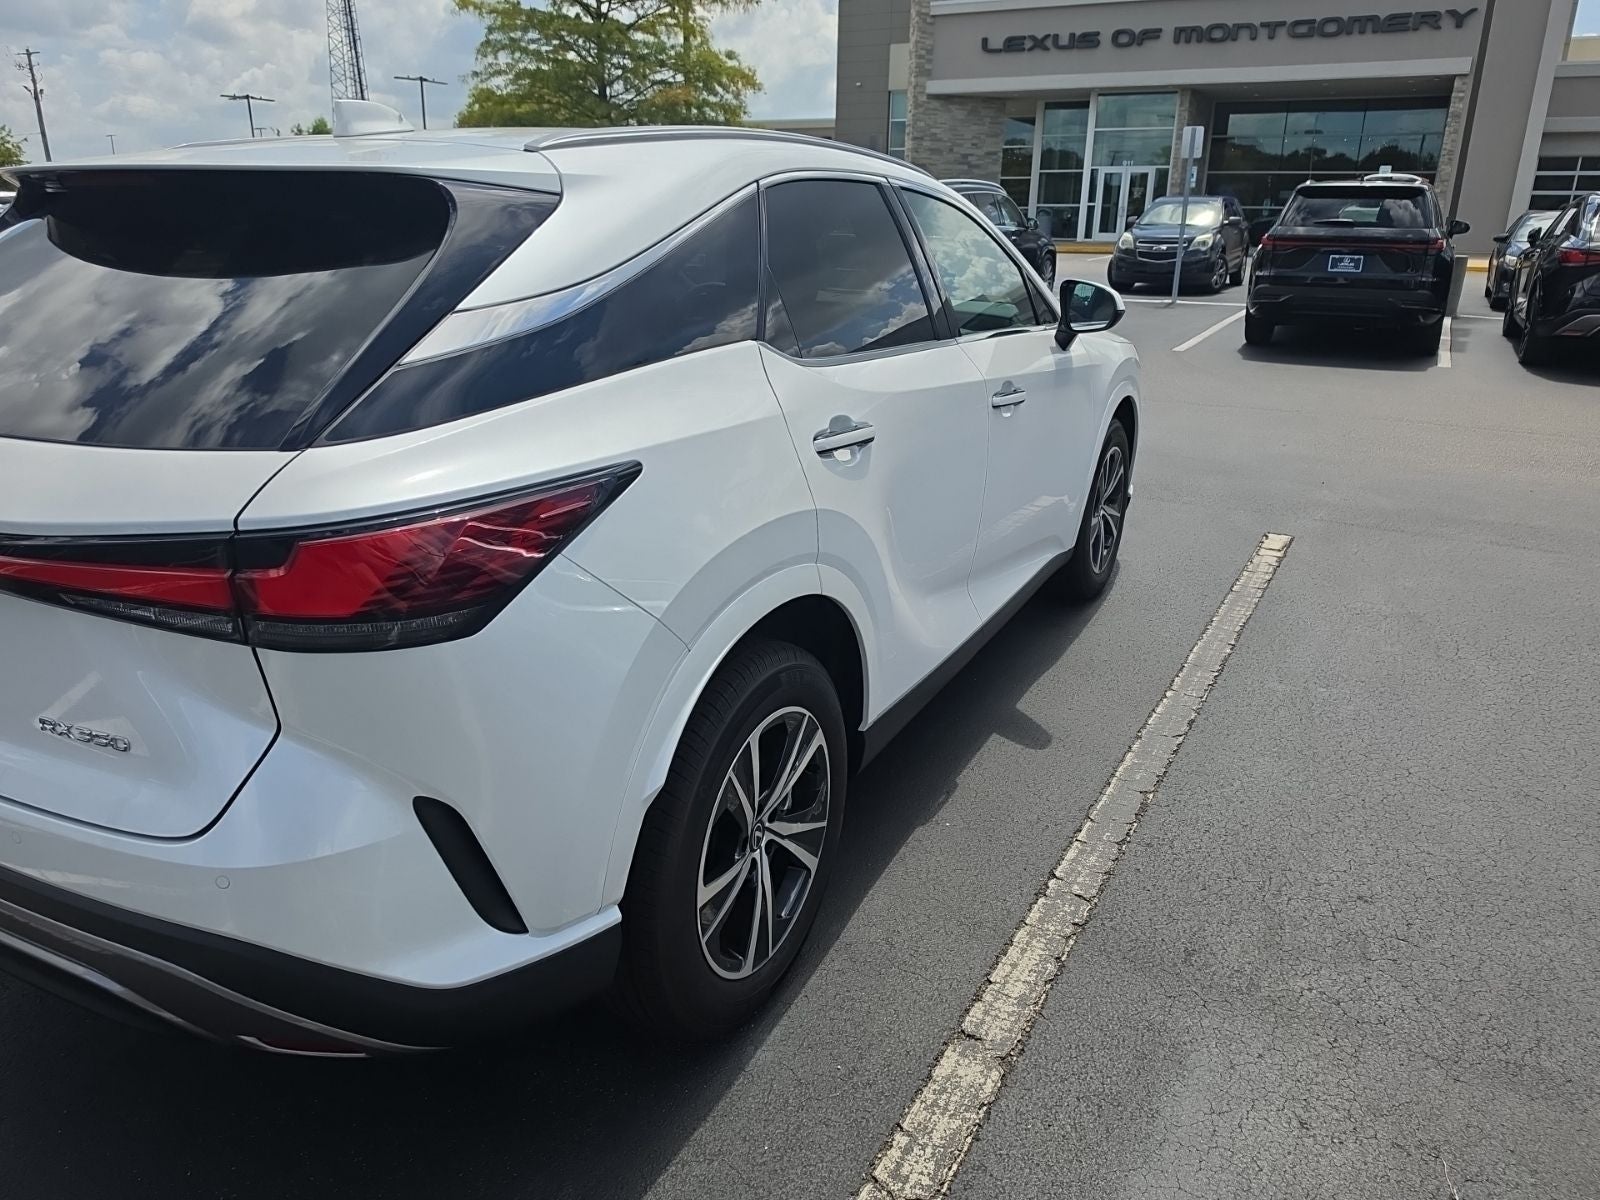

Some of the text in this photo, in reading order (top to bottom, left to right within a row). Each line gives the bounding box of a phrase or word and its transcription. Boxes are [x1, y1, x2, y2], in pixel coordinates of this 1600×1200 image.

[981, 7, 1478, 54] LEXUS OF MONTGOMERY
